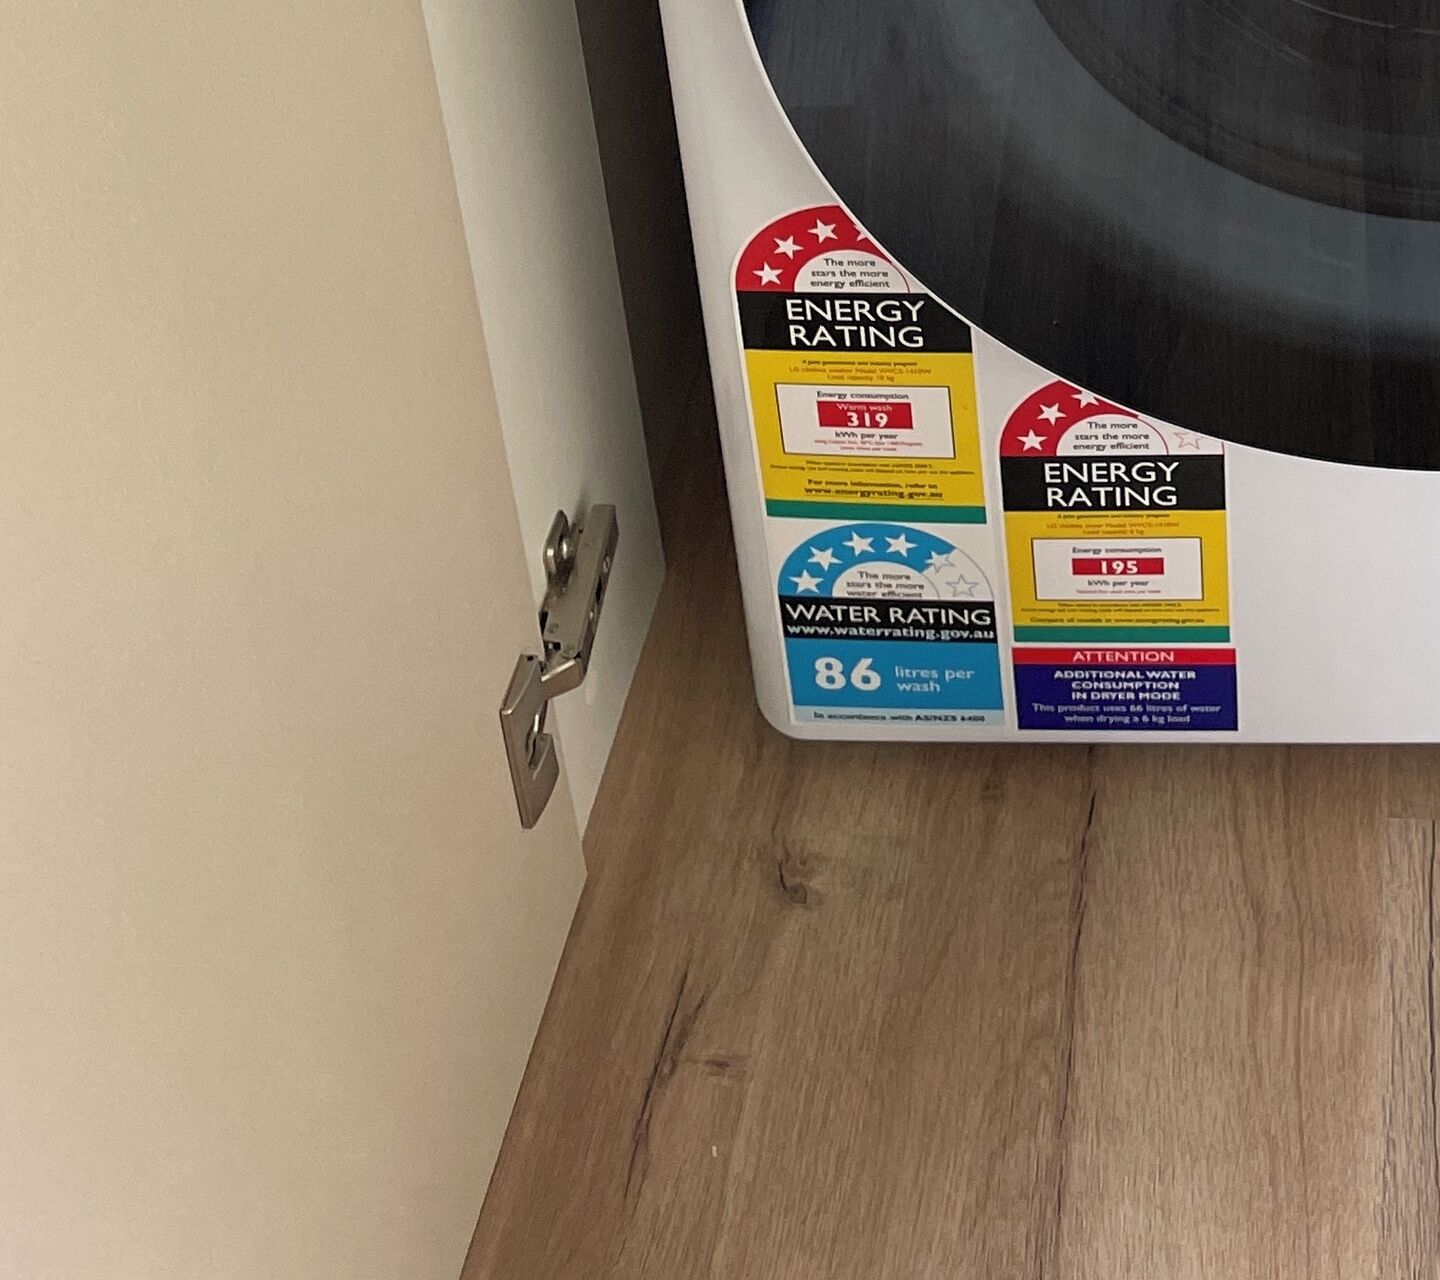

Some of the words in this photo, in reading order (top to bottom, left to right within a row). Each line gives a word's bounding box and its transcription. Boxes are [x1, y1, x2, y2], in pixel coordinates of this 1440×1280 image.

[824, 258, 844, 268] The
[847, 259, 876, 268] more
[811, 269, 836, 278] stars
[840, 269, 856, 278] the
[859, 270, 889, 278] more
[811, 280, 845, 289] energy
[849, 279, 890, 288] efficient
[785, 298, 925, 323] ENERGY
[789, 325, 925, 348] RATING
[817, 391, 847, 400] Energy
[850, 392, 909, 401] consumption
[836, 403, 867, 411] Warm
[869, 404, 893, 412] wash
[846, 412, 888, 428] 319
[1087, 421, 1107, 430] The
[1110, 422, 1138, 430] more
[1075, 433, 1099, 441] stars
[1102, 432, 1119, 441] the
[1073, 443, 1107, 452] energy
[1110, 442, 1150, 450] efficient
[1044, 461, 1180, 484] ENERGY
[1046, 486, 1178, 508] RATING
[1072, 546, 1102, 555] Energy
[1100, 560, 1138, 574] 195
[857, 571, 879, 580] The
[785, 603, 881, 624] WATER
[889, 607, 991, 625] RATING
[787, 624, 994, 641] www.waterrating.gov.au
[1072, 651, 1175, 662] ATTENTION
[814, 656, 881, 691] 86
[895, 665, 939, 680] litres
[945, 668, 975, 682] per
[1054, 670, 1144, 679] ADDITIONAL
[1146, 670, 1196, 679] WATER
[897, 680, 941, 693] wash
[1071, 681, 1180, 690] CONSUMPTION
[1072, 691, 1087, 700] IN
[1091, 691, 1135, 700] DRYER
[1139, 691, 1180, 700] MODE
[1032, 703, 1055, 712] This
[1058, 704, 1100, 713] product
[1176, 704, 1188, 712] of
